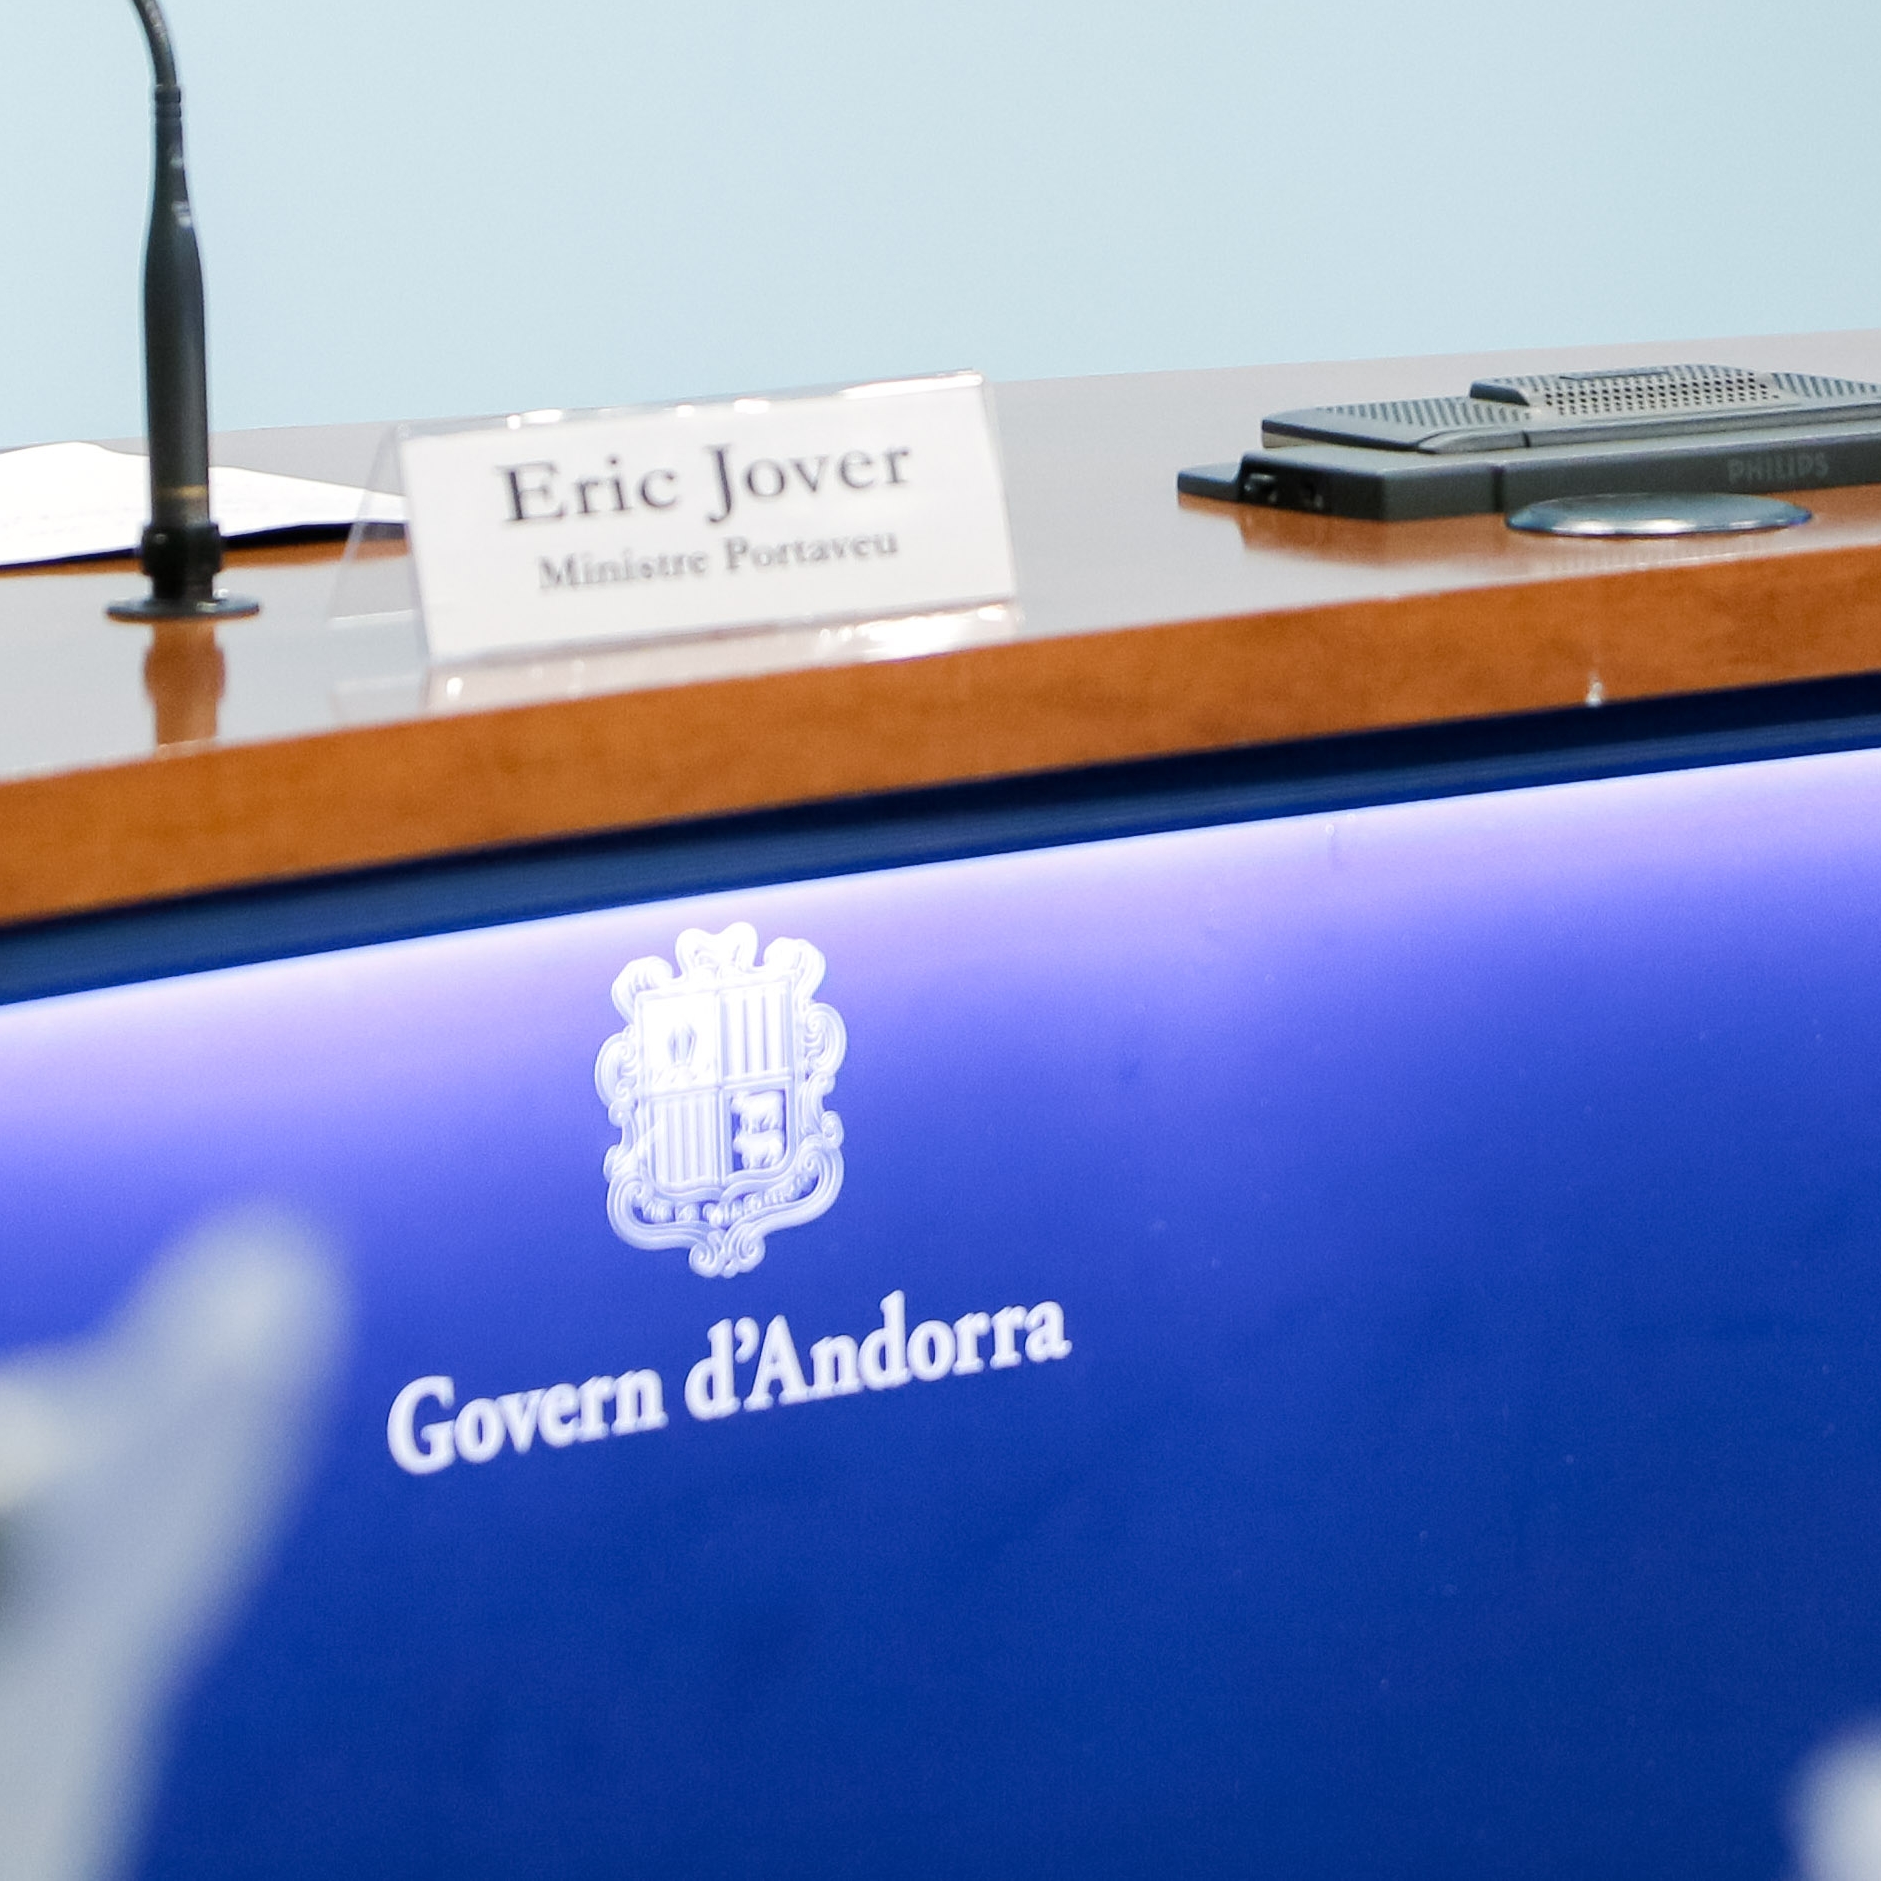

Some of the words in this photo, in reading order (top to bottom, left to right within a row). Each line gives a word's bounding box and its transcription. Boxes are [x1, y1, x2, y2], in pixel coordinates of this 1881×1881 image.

[497, 454, 680, 523] Eric
[703, 442, 910, 524] Jover
[1727, 451, 1829, 484] PHILIPS
[540, 547, 709, 589] Ministre
[724, 530, 899, 573] Portaveu
[386, 1368, 669, 1475] Govern
[684, 1290, 1073, 1421] d’Andorra
